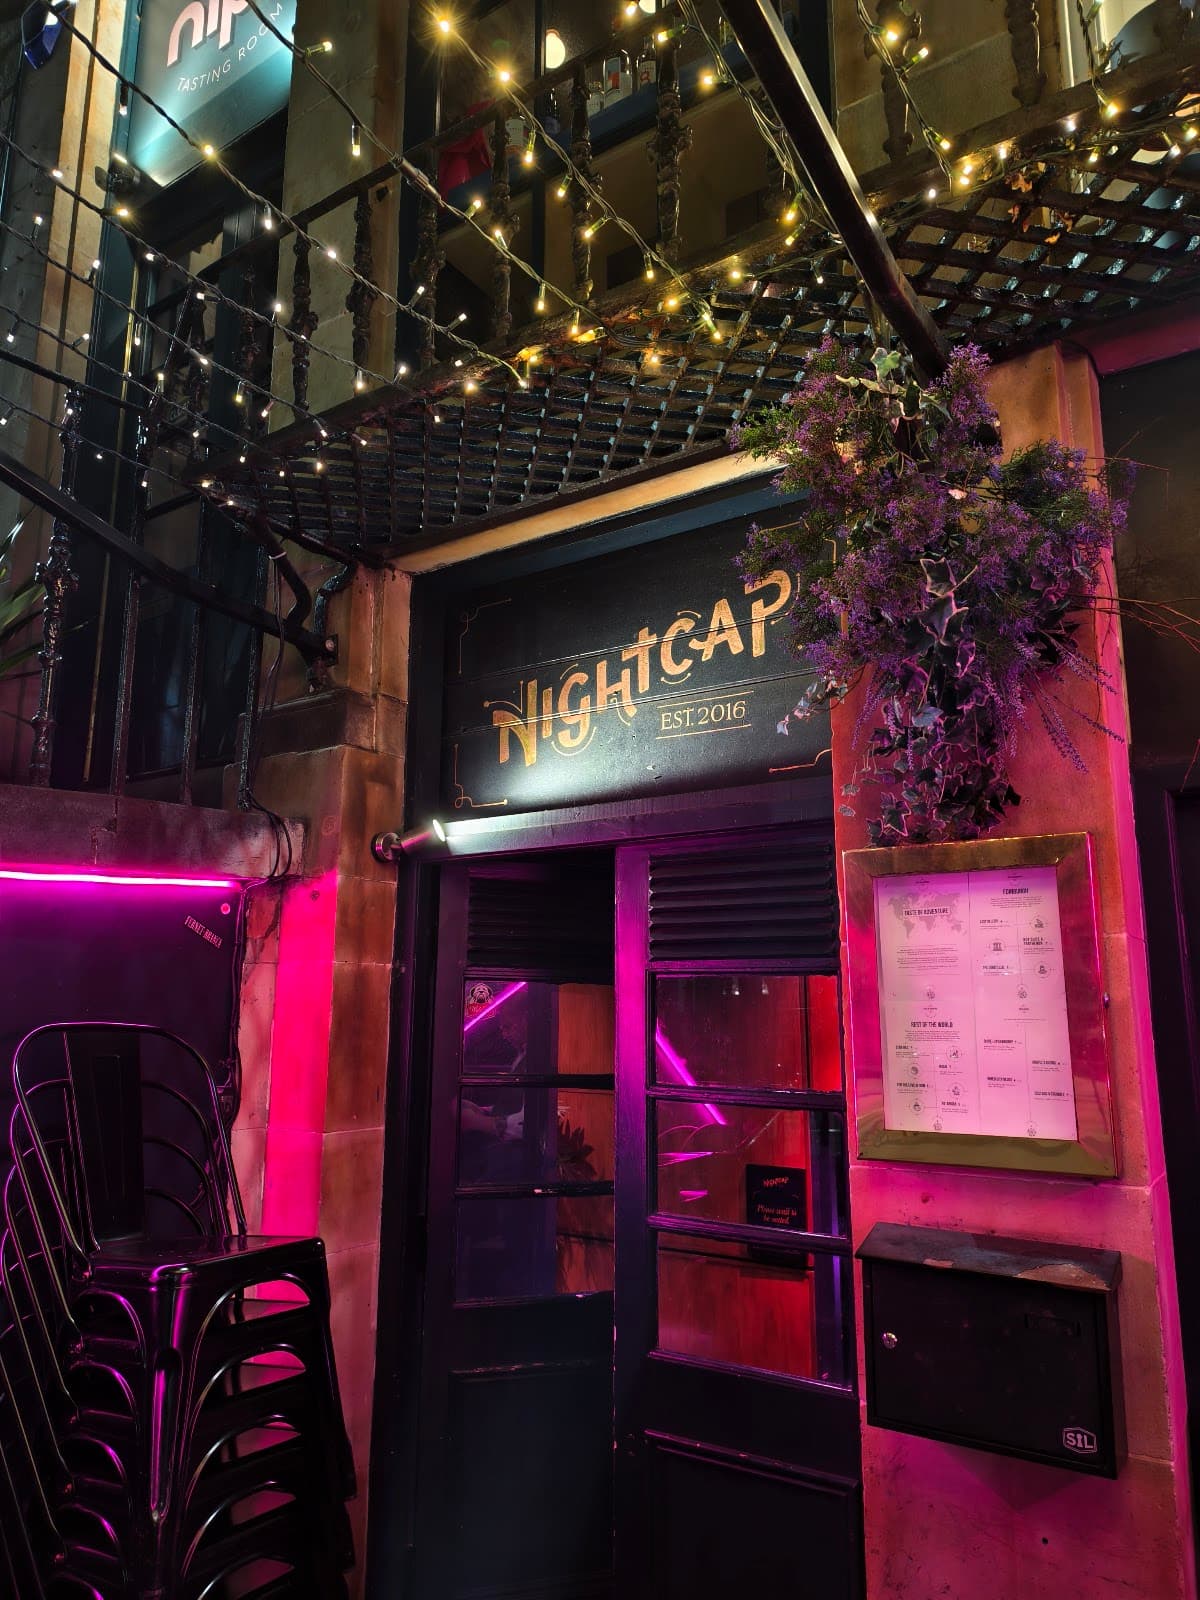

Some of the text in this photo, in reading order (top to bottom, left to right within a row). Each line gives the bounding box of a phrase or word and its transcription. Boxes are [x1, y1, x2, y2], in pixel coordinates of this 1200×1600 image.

[178, 3, 283, 92] TASTING ROOM
[660, 700, 747, 730] EST. 2016
